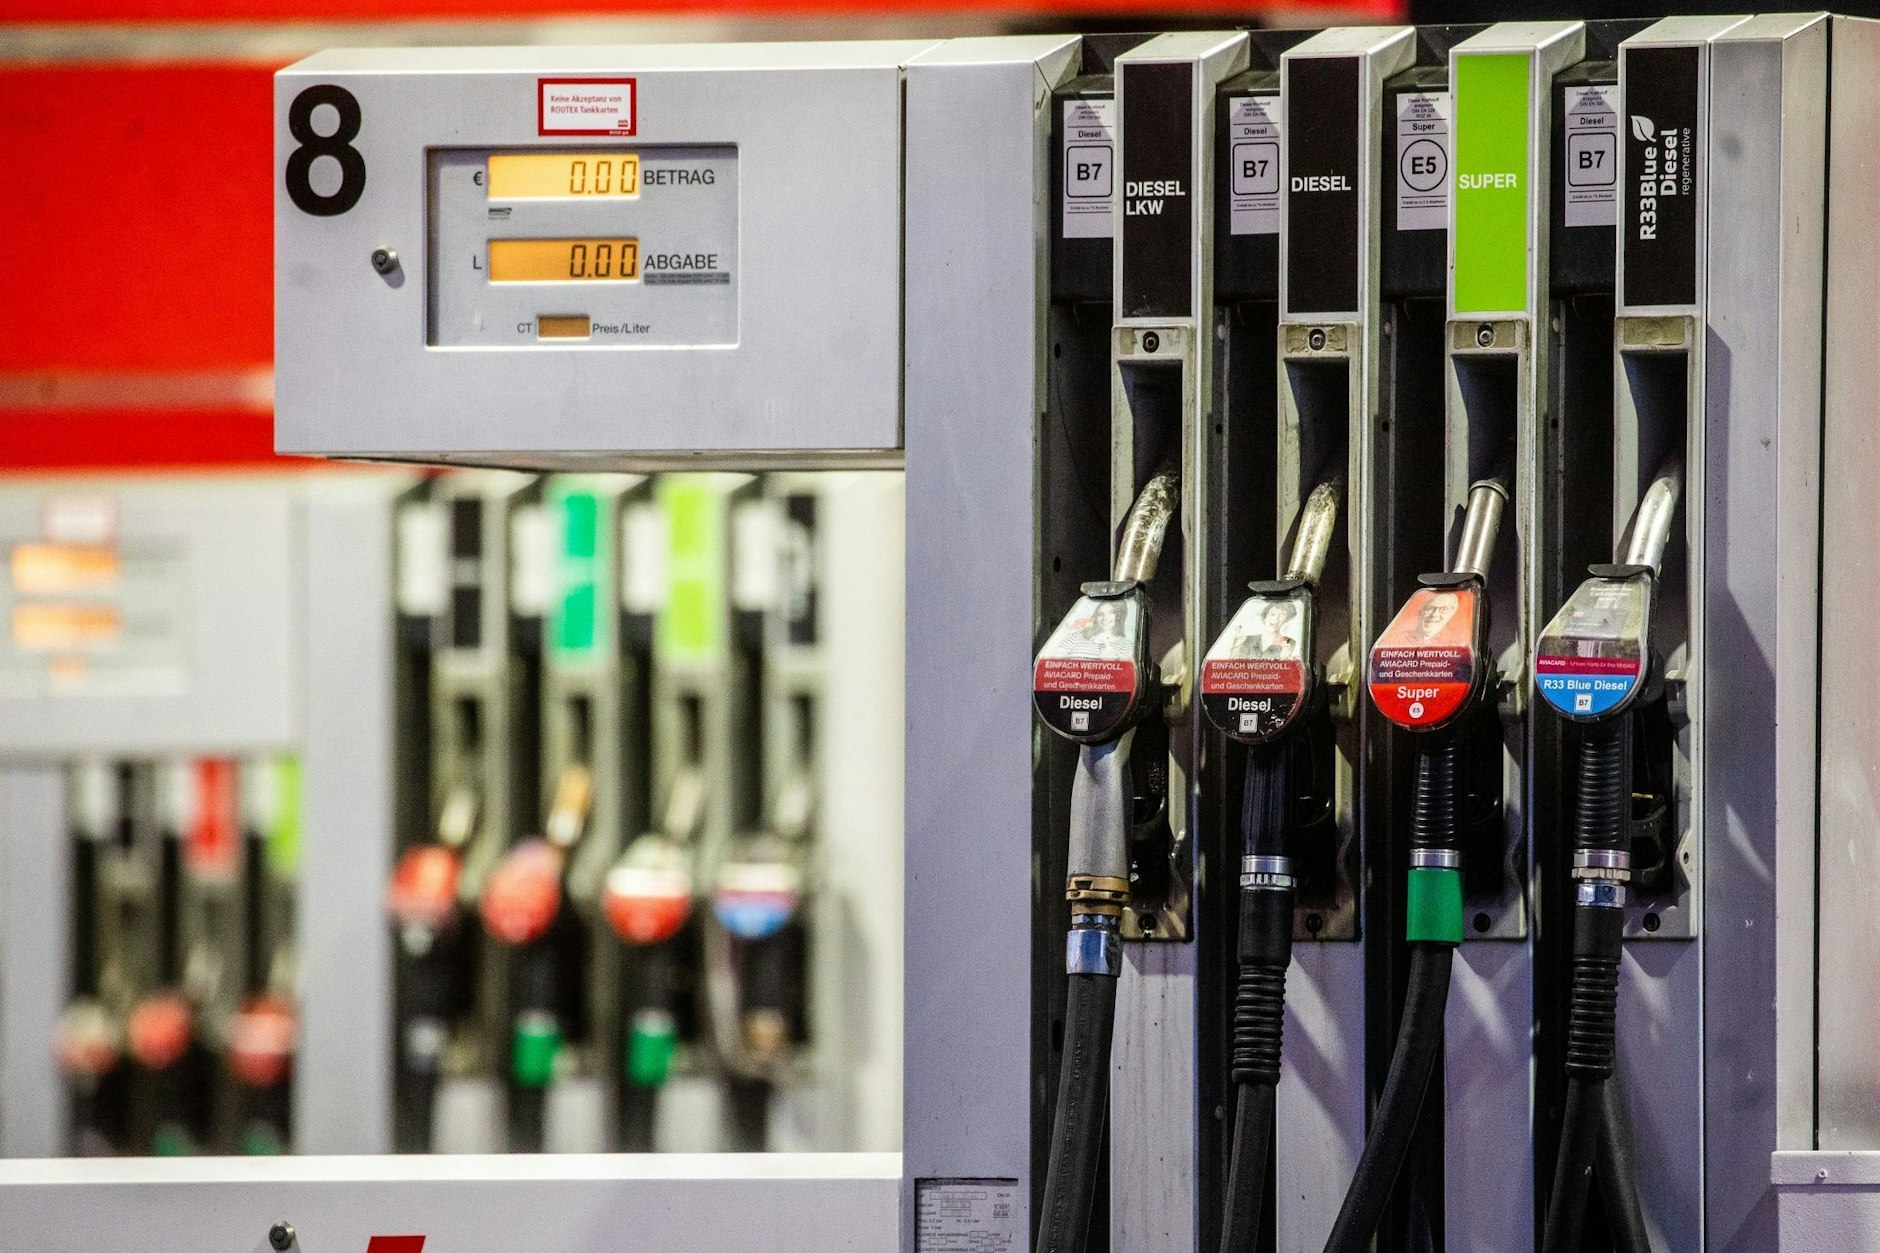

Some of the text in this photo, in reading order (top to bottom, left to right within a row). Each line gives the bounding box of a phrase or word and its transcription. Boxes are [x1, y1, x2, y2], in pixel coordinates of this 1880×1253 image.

[571, 95, 608, 104] Akzeptanz
[550, 106, 618, 114] ROUTEX Tankkarten
[1580, 117, 1604, 125] Diesel
[1244, 127, 1268, 135] Diesel
[1412, 123, 1435, 132] Super
[1078, 130, 1102, 138] Diesel
[285, 84, 367, 217] 8
[1412, 156, 1437, 175] E5
[1579, 150, 1605, 169] B7
[1659, 128, 1678, 196] Diesel
[1681, 128, 1692, 196] regenerative
[1076, 163, 1102, 181] B7
[1243, 160, 1268, 178] B7
[474, 160, 716, 194] € 0.00 BETRAG
[1459, 173, 1518, 190] SUPER
[1126, 180, 1186, 198] DIESEL
[1291, 176, 1352, 192] DIESEL
[1126, 199, 1164, 216] LKW
[474, 244, 718, 278] L 0.00 ABGABE
[516, 323, 533, 334] CT
[1381, 650, 1461, 658] EINFACH WERTVOLL.
[1045, 660, 1124, 671] EINFACH WERTVOLL.
[1212, 662, 1291, 670] EINFACH WERTVOLL.
[1420, 660, 1451, 669] Prepaid-
[1044, 671, 1114, 682] AVIACARD Prepaid-
[1211, 672, 1281, 682] AVIACARD Prepaid-
[1394, 670, 1453, 678] Geschenkkarten
[1058, 682, 1116, 690] Geschenkkarten
[1226, 682, 1284, 691] Geschenkkarten
[1544, 680, 1628, 692] R33 Blue Diesel
[1397, 686, 1440, 702] Super
[1060, 695, 1103, 710] Diesel
[1228, 697, 1272, 712] Diesel
